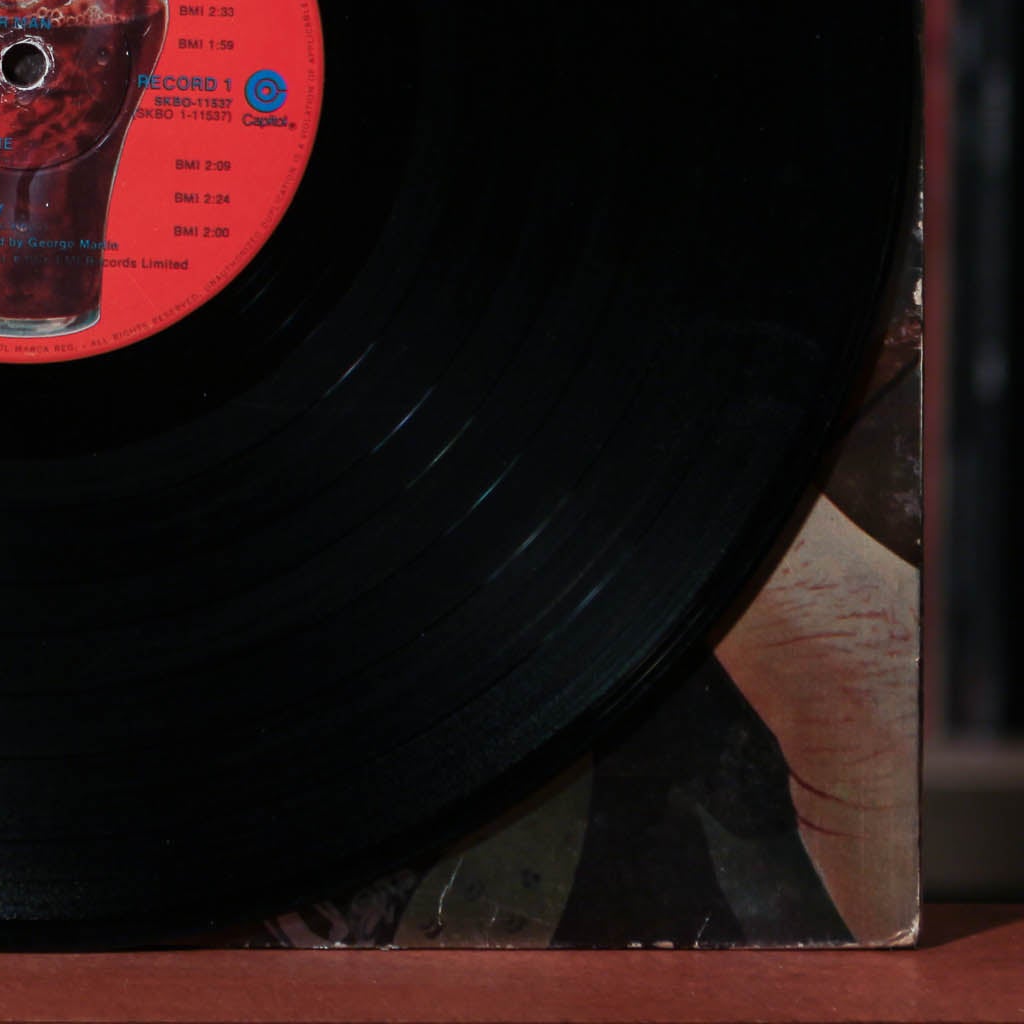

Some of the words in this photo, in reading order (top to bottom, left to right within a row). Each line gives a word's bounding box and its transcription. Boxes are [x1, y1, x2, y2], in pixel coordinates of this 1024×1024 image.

[179, 5, 204, 17] BMI
[12, 16, 51, 30] MAN
[178, 38, 203, 50] BMI
[137, 74, 218, 92] RECORD
[223, 78, 232, 92] 1
[154, 96, 233, 109] SKBO-11537
[242, 113, 288, 129] Capitol
[175, 159, 201, 171] BMI
[174, 193, 200, 204] BMI
[173, 226, 199, 238] BMI
[8, 235, 24, 249] by
[28, 237, 75, 251] George
[79, 239, 119, 252] Martin
[85, 257, 138, 270] Rcords
[141, 258, 189, 271] Limited
